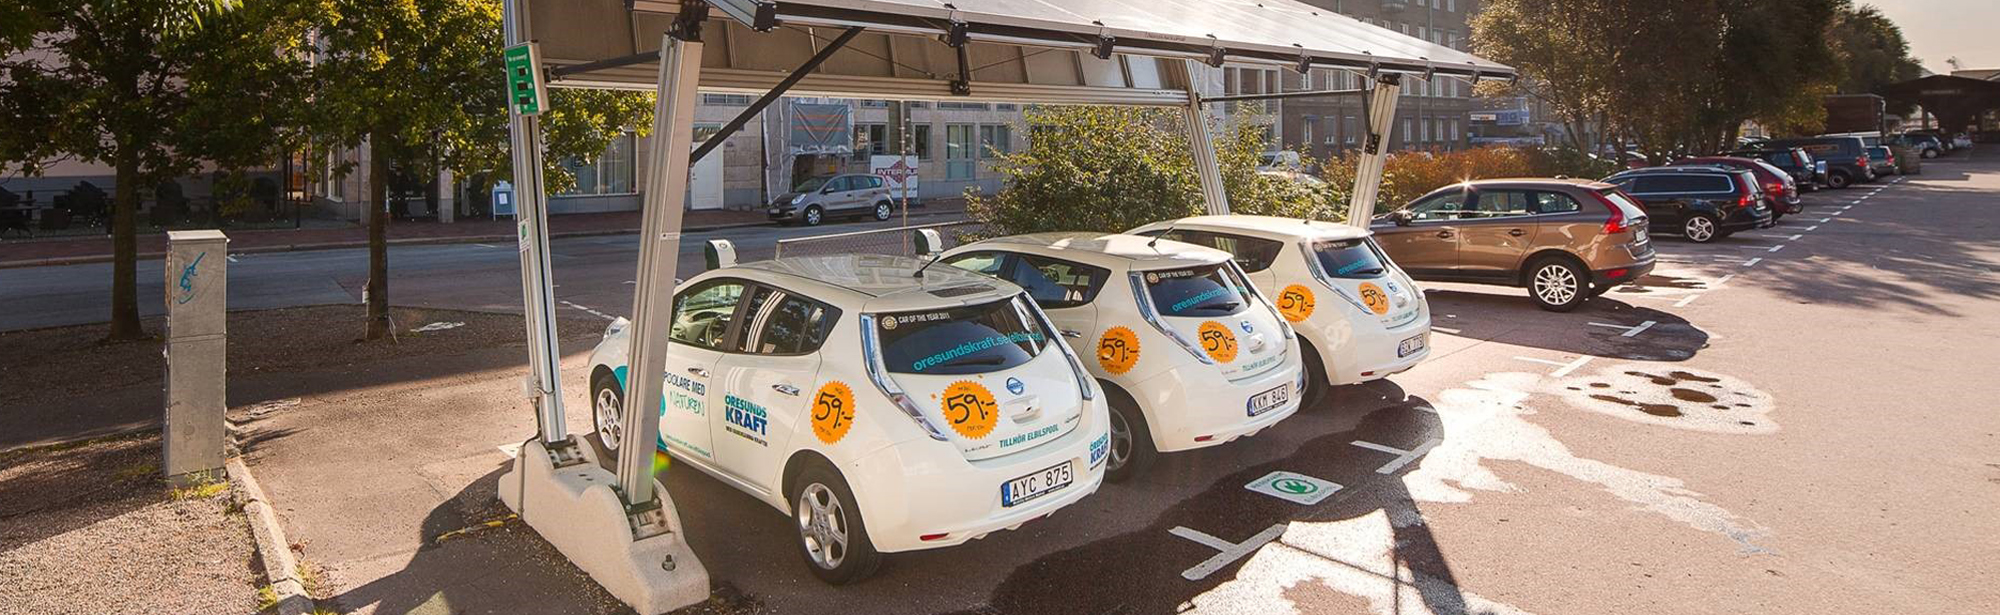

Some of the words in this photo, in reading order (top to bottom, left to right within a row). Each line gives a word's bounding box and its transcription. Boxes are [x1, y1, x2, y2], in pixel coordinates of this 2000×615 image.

[692, 381, 705, 396] MED
[725, 406, 768, 436] KRAFT
[1027, 424, 1059, 441] ELBILSPOOL
[1012, 476, 1037, 500] AYC
[1045, 465, 1069, 487] 875
